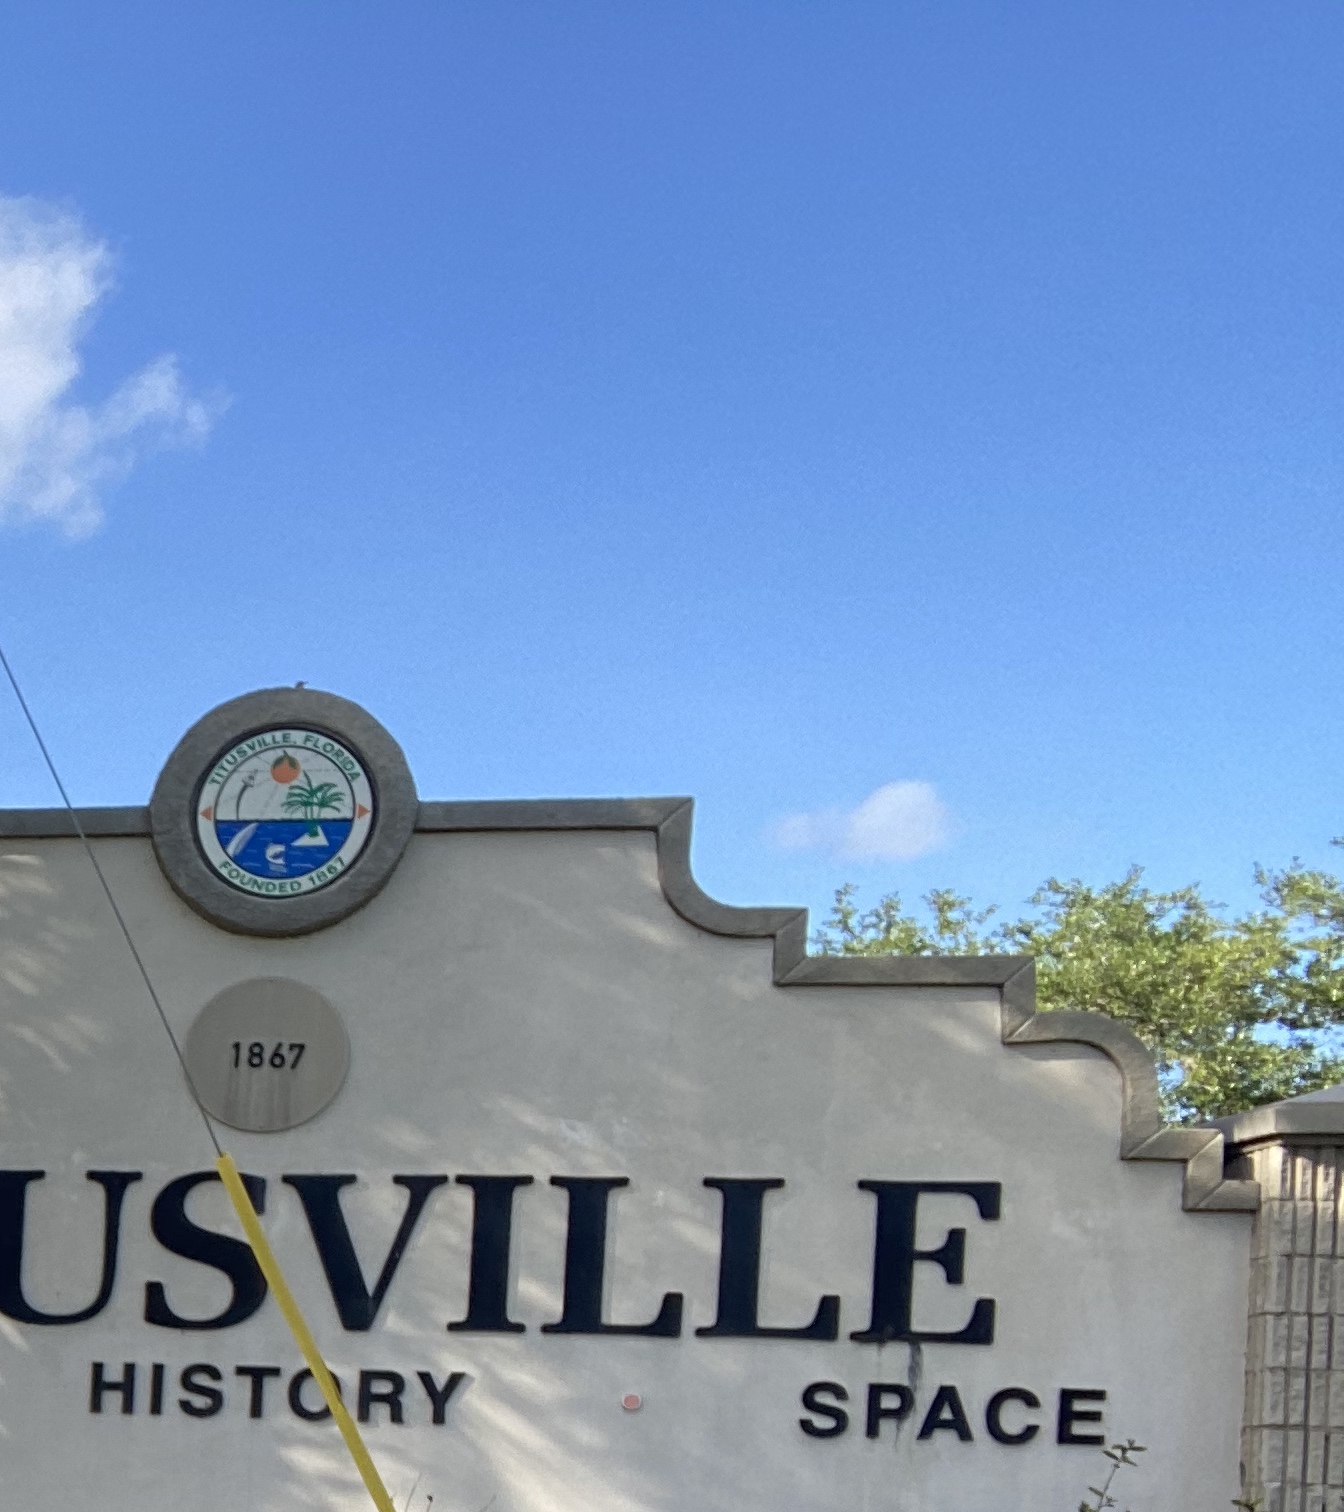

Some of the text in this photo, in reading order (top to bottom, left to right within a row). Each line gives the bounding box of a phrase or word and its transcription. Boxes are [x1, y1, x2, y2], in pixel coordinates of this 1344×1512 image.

[303, 733, 361, 783] FLORIDA
[218, 856, 346, 893] FOUNDED 1867
[231, 1041, 306, 1070] 1867
[88, 1361, 467, 1426] HISTORY
[798, 1380, 1108, 1447] SPACE
